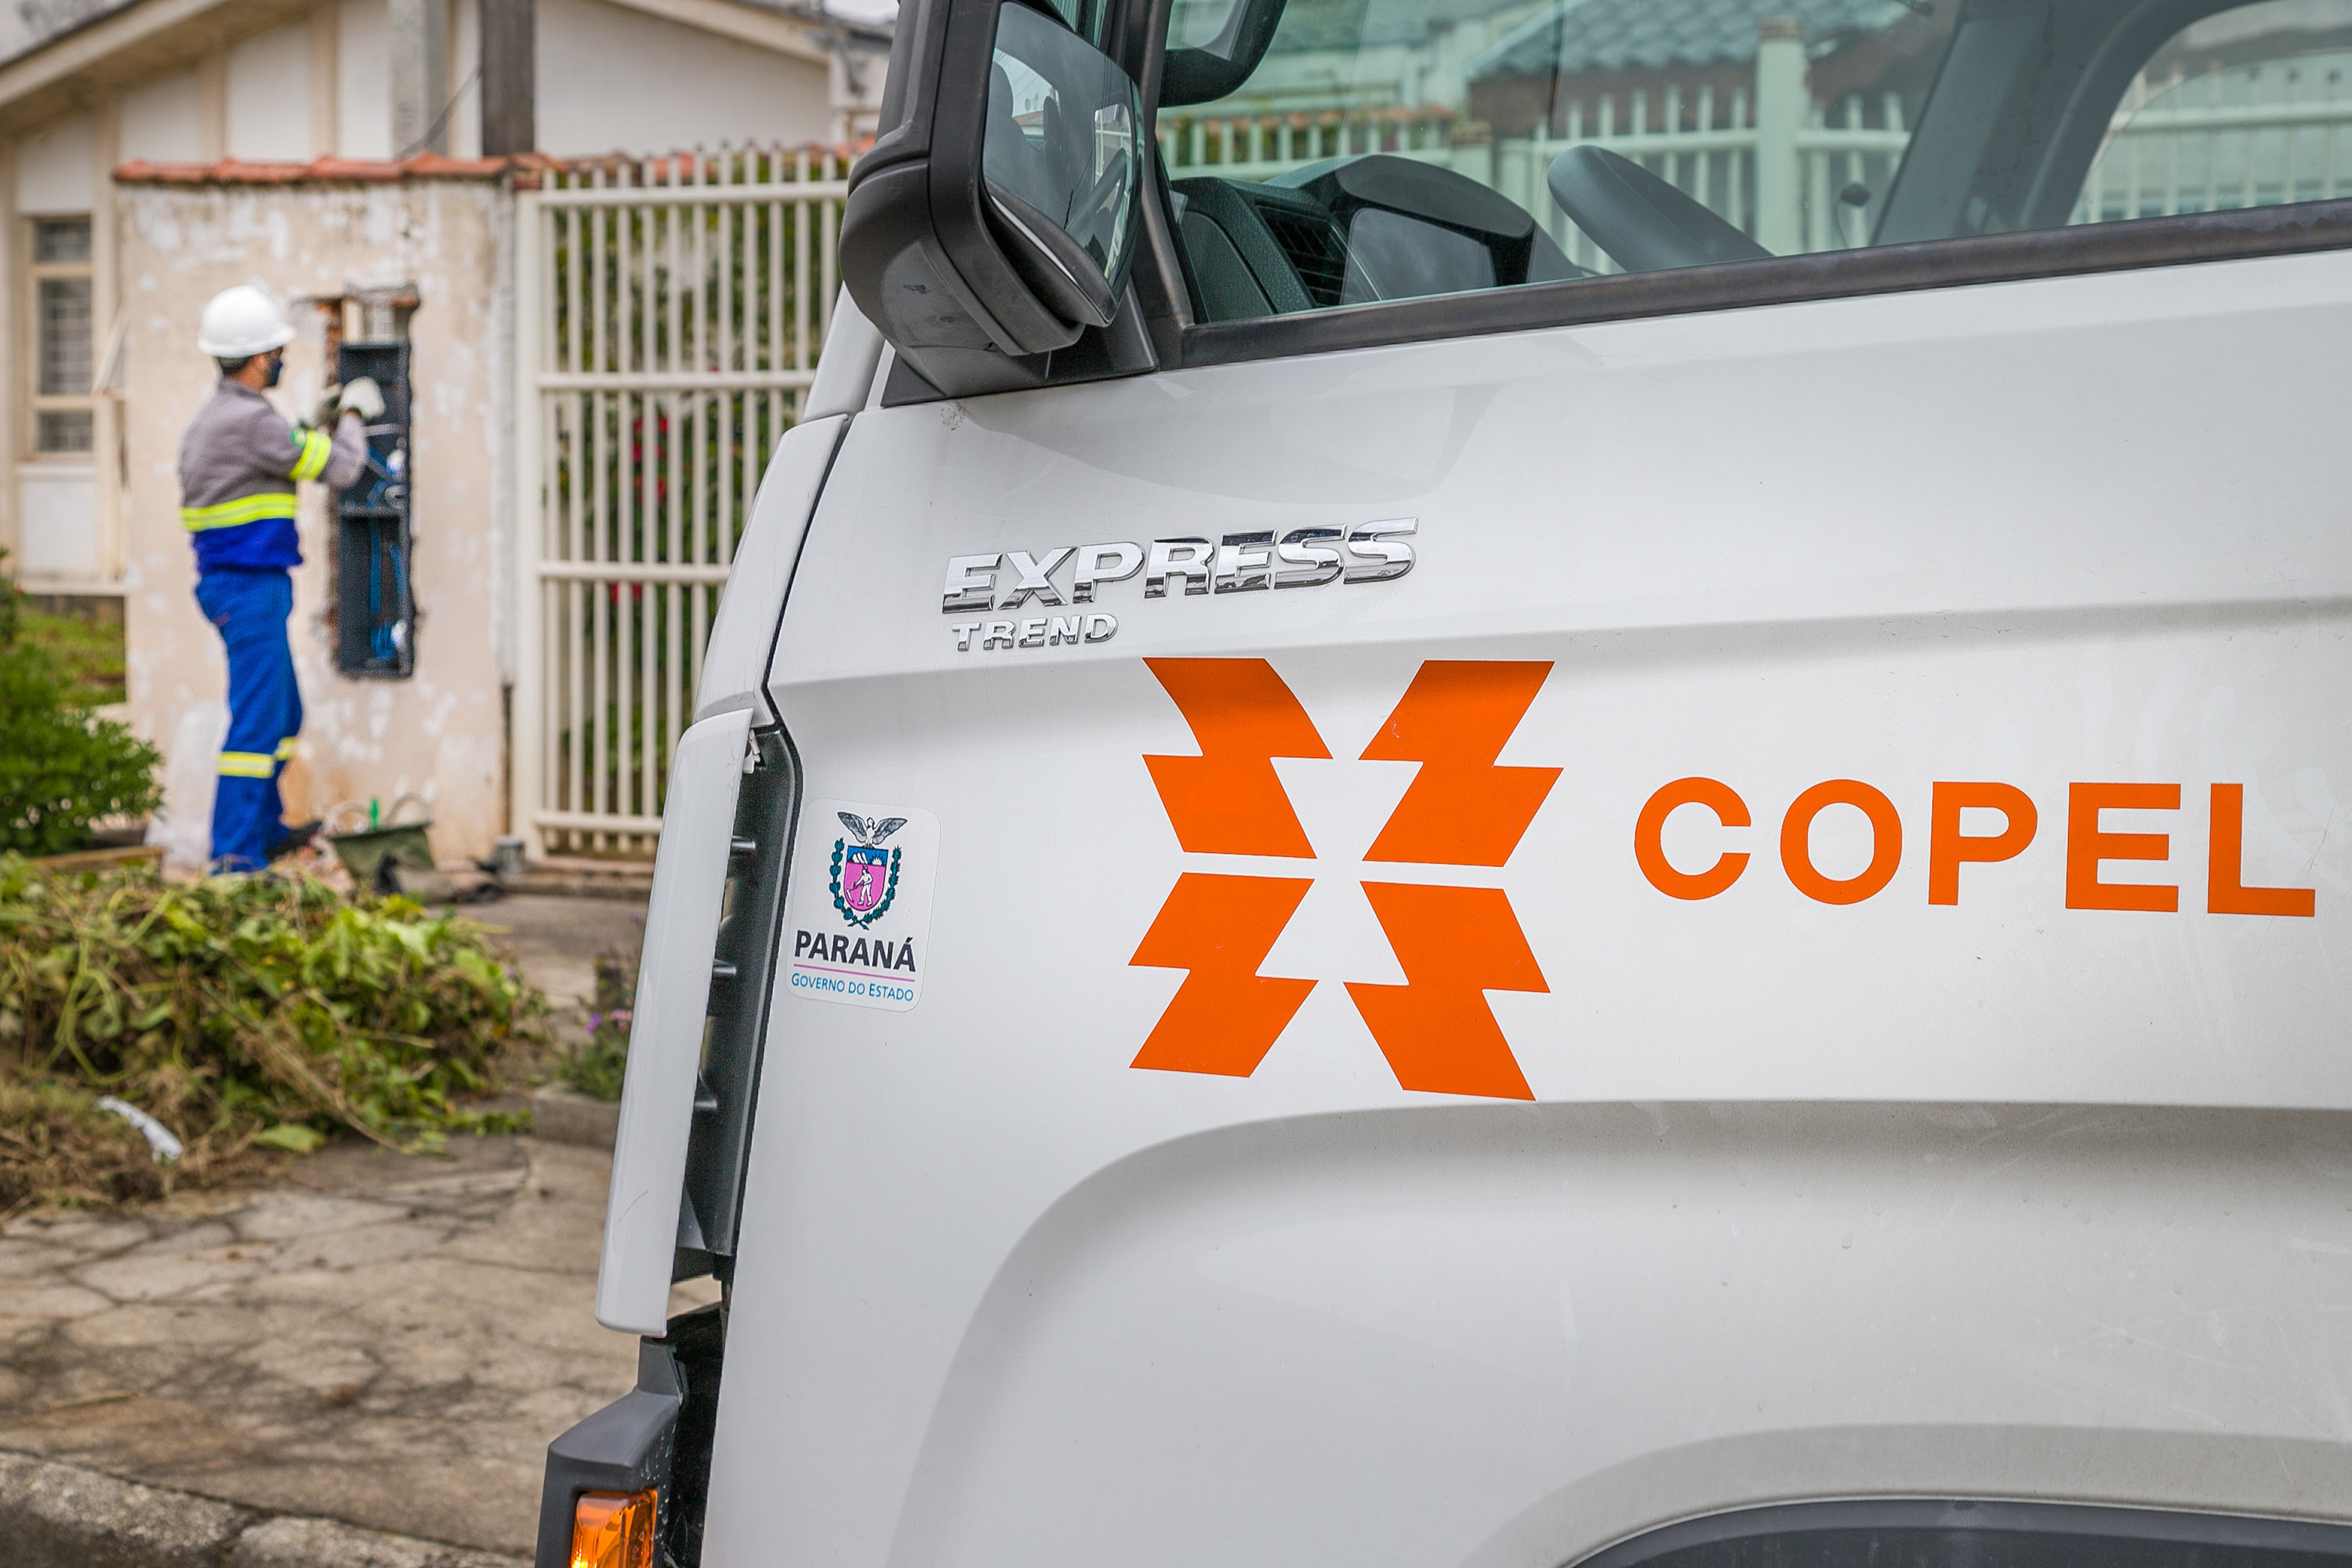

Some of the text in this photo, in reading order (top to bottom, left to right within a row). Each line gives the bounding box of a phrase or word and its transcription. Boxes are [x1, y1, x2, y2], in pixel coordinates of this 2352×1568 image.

[942, 517, 1418, 614] EXPRESS
[952, 613, 1119, 652] TREND
[1635, 777, 2316, 916] COPEL
[794, 930, 916, 972] PARANÁ
[791, 972, 914, 1001] GOVERNO DO ESTADO
